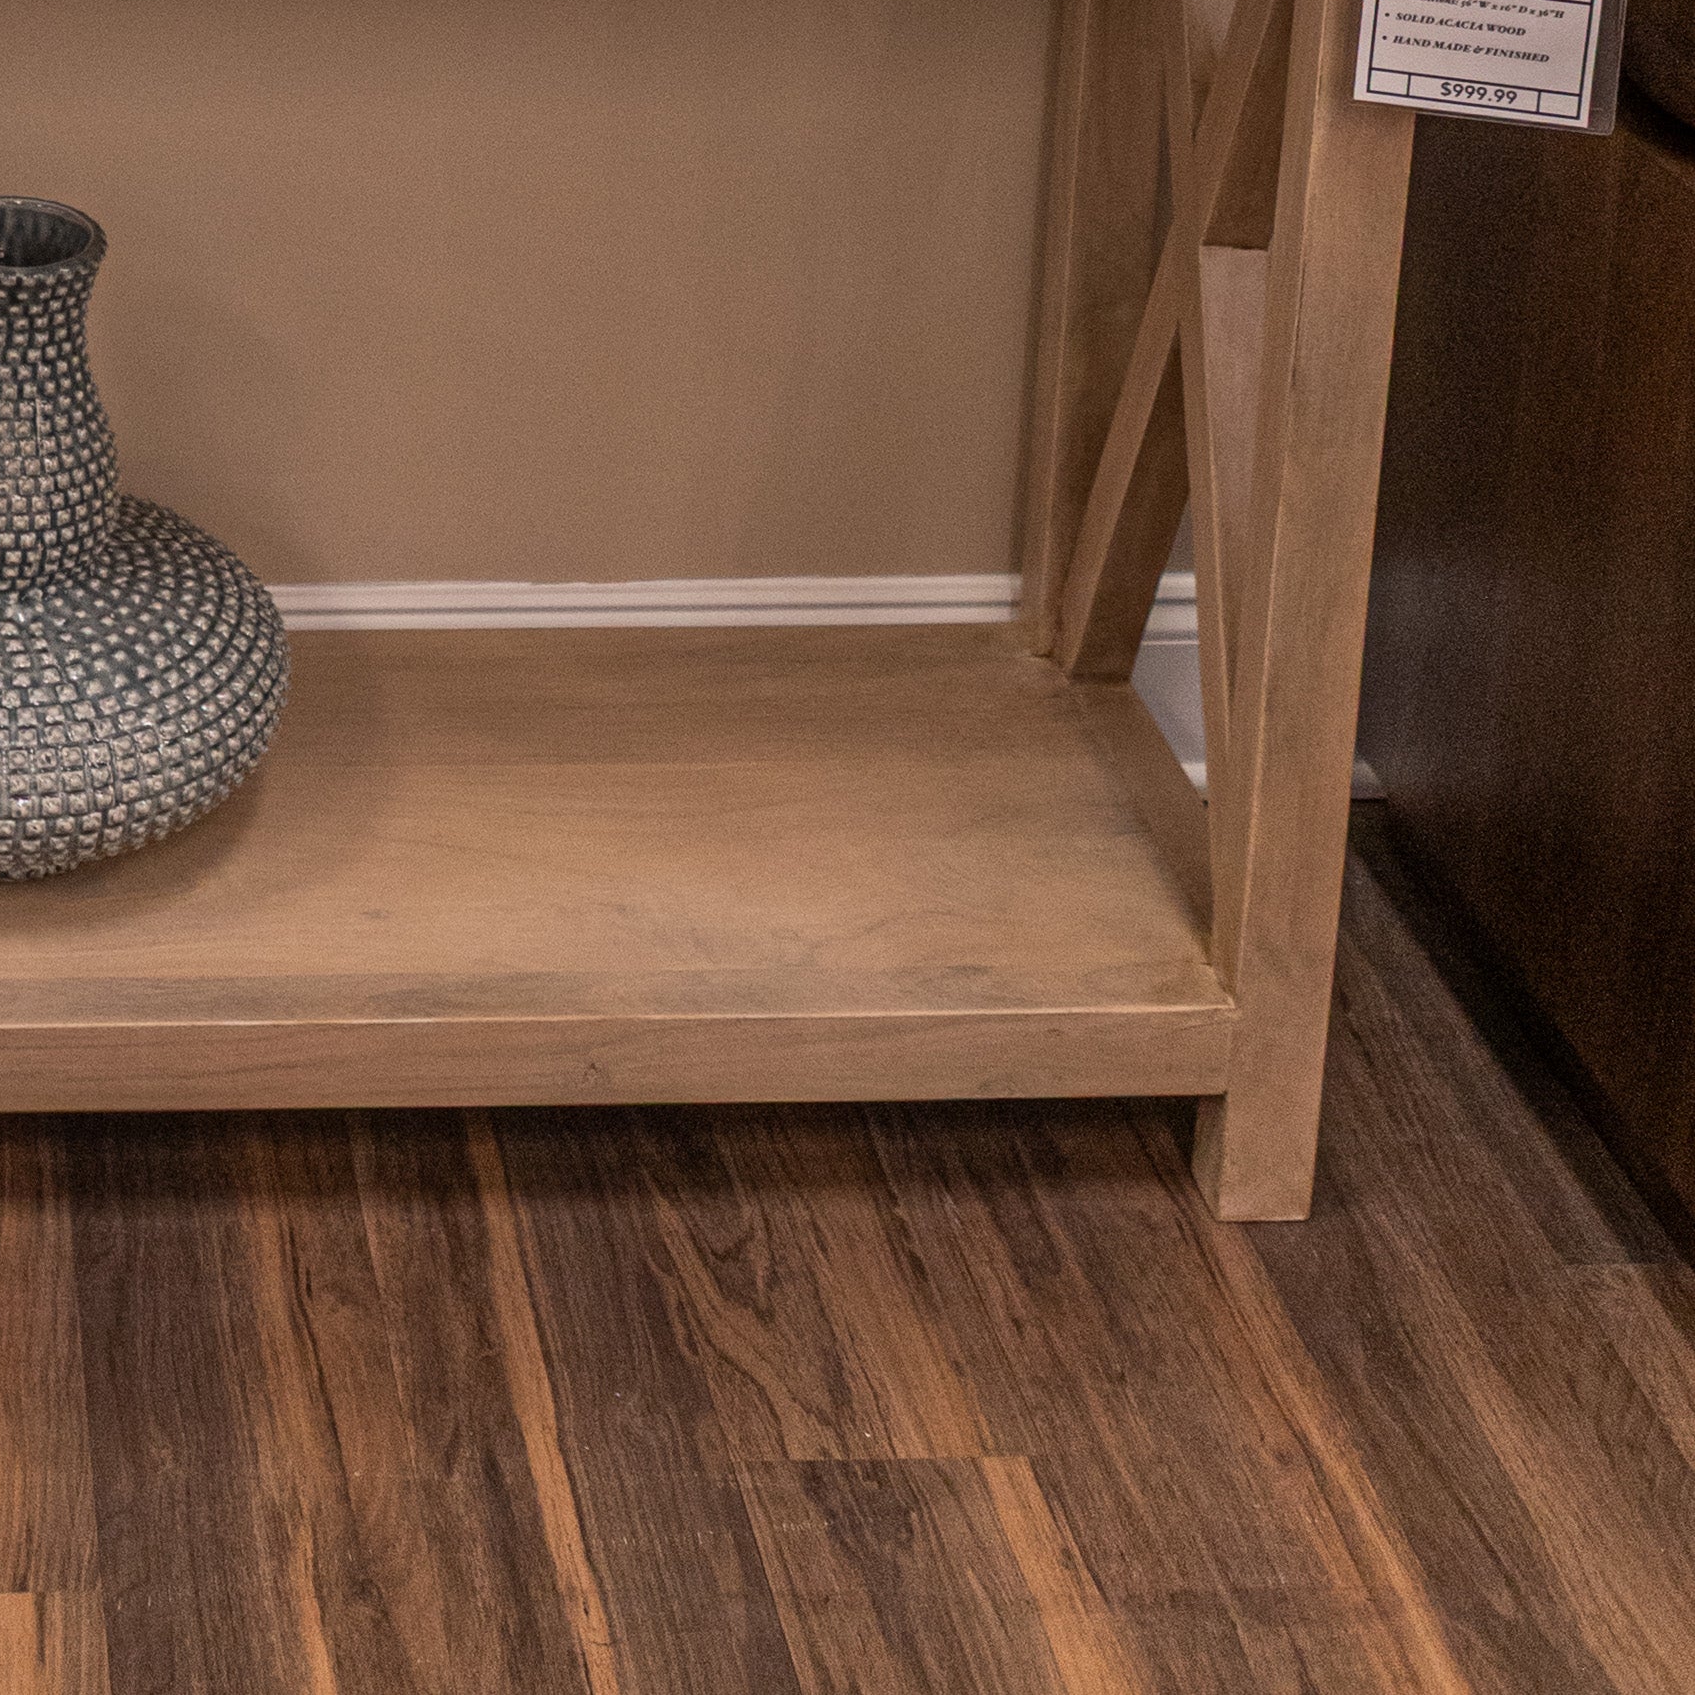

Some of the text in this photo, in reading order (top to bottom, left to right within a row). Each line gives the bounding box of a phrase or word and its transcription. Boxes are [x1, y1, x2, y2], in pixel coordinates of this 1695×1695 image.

[1395, 11, 1527, 37] SOLID ACACIA WOOD
[1392, 34, 1550, 64] HAND MADE & FINISHED
[1440, 81, 1518, 105] $999.99
